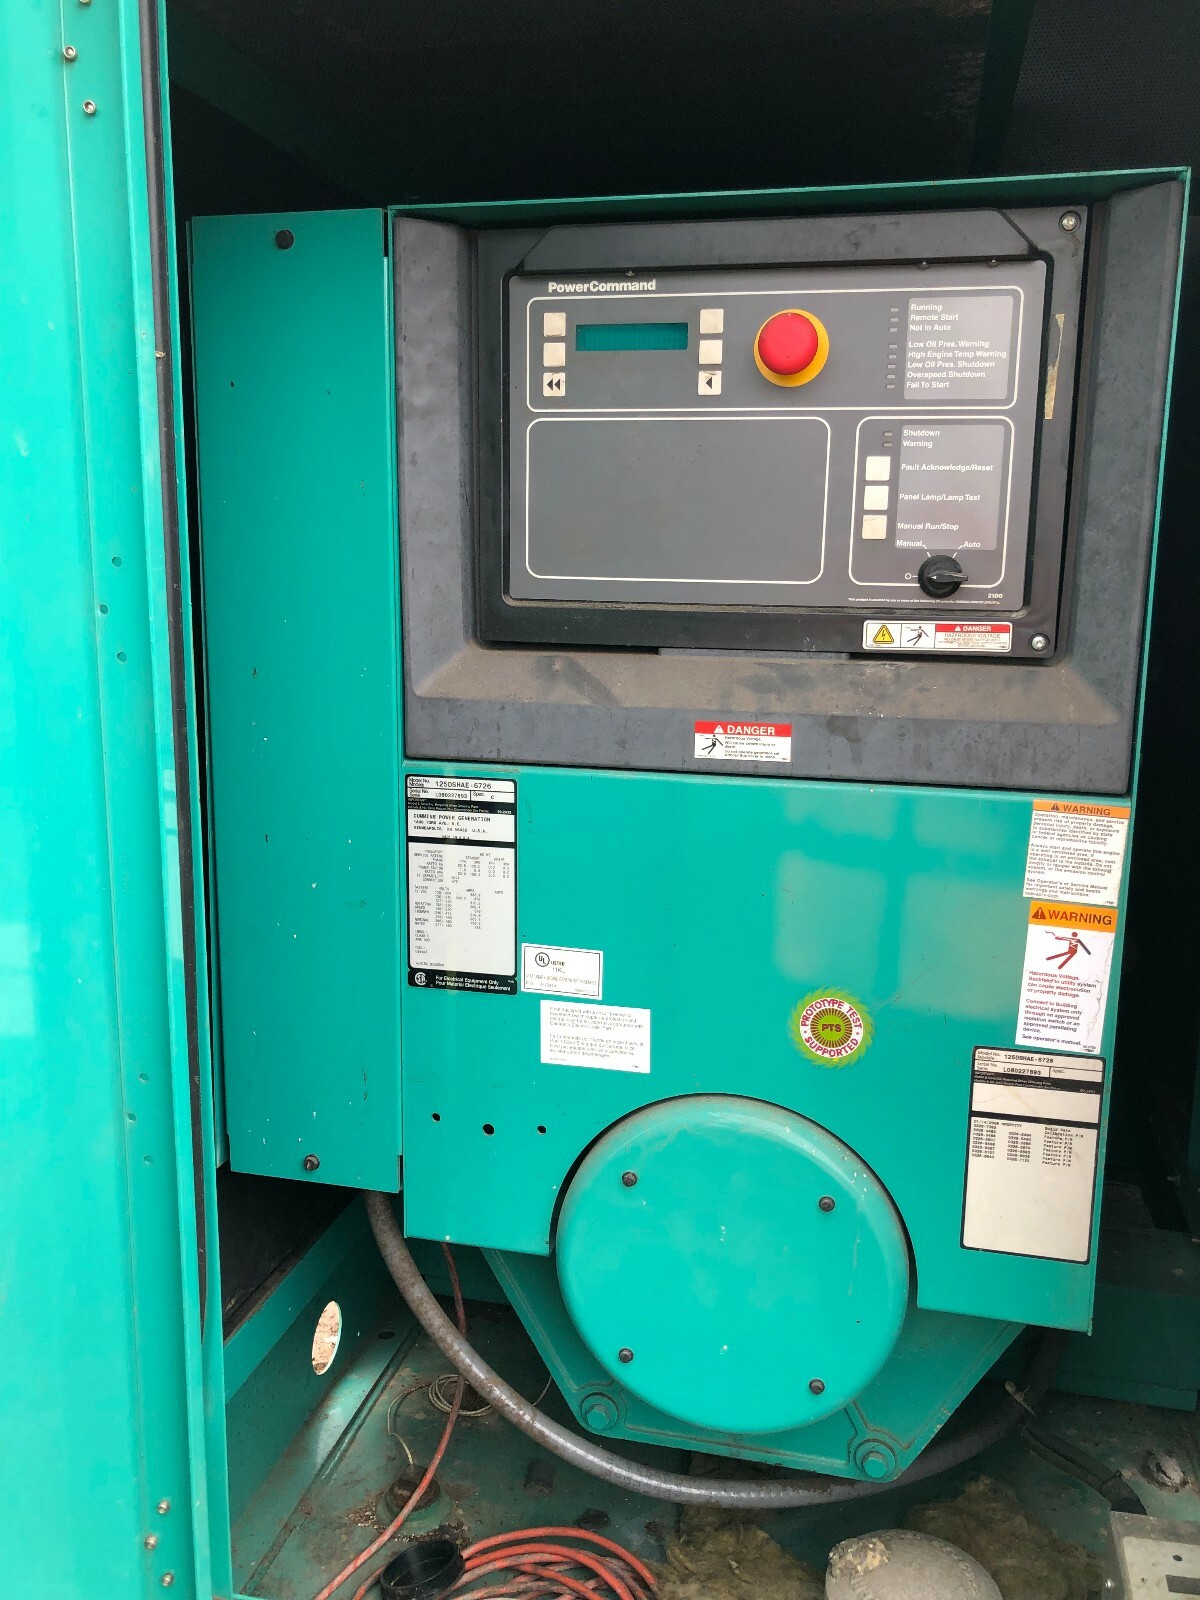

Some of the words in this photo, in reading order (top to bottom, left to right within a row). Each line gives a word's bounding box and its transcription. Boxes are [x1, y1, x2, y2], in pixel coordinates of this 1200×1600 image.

[549, 280, 656, 293] PowerCommand
[958, 340, 989, 348] Warning
[728, 726, 775, 735] DANGER
[1063, 805, 1111, 816] WARNING
[1048, 910, 1112, 925] WARNING
[800, 999, 844, 1026] PROTOTYPE
[846, 1006, 862, 1029] TEST
[822, 1024, 842, 1032] PTS
[805, 1036, 858, 1057] SUPPORTED
